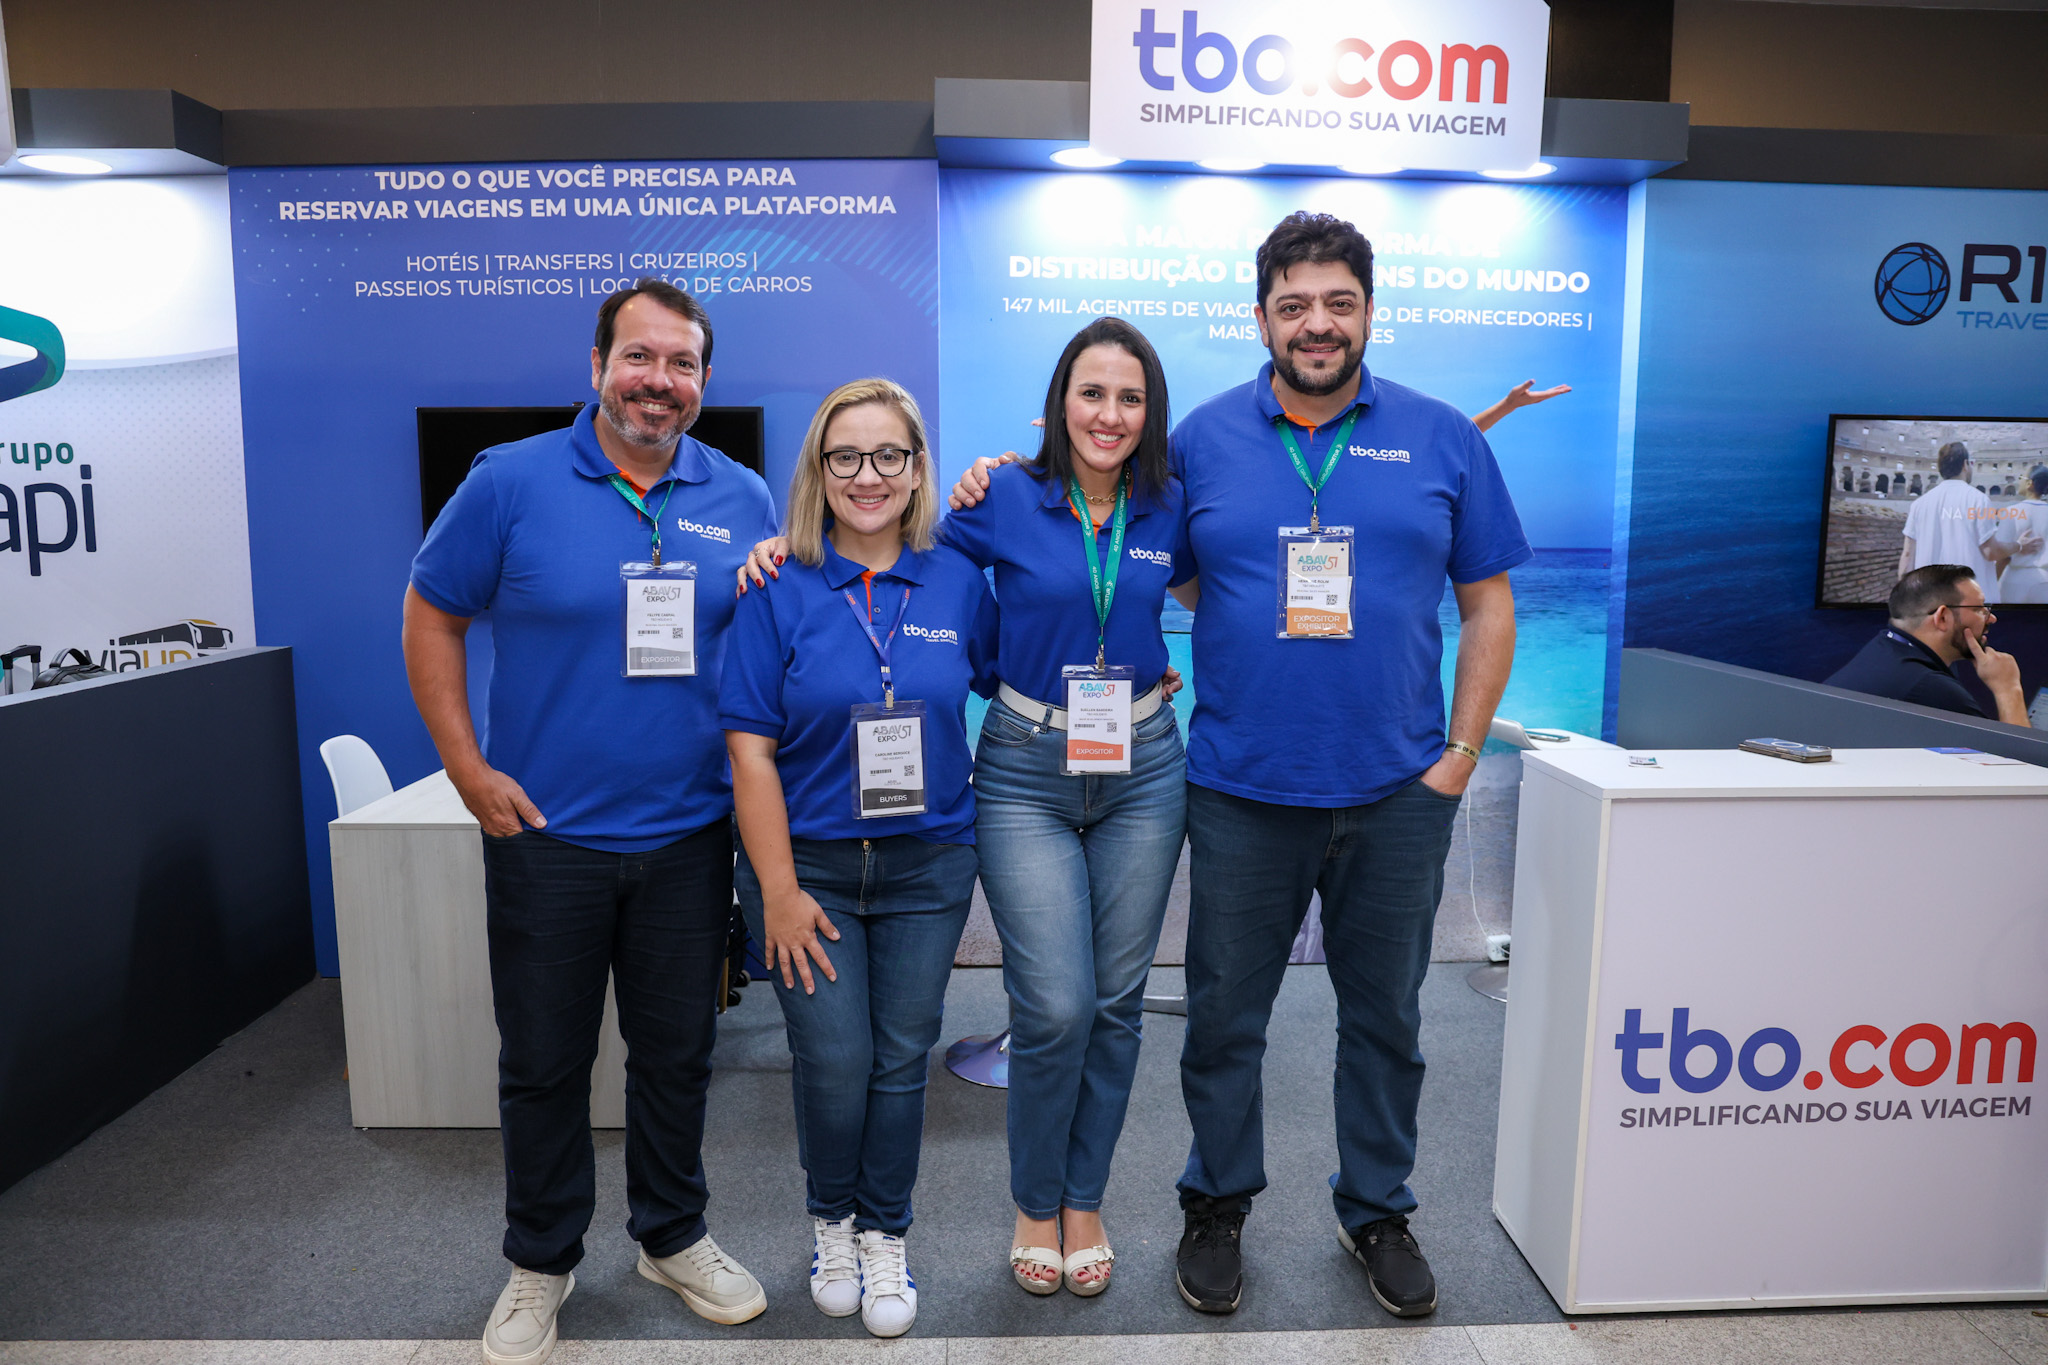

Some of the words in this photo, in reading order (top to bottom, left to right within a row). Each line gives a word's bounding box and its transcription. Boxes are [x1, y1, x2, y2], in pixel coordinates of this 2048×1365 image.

[1133, 8, 1509, 104] tbo.com
[1139, 103, 1342, 129] SIMPLIFICANDO
[1348, 111, 1401, 132] SUA
[1407, 112, 1507, 136] VIAGEM
[374, 170, 445, 190] TUDO
[452, 170, 471, 189] O
[478, 169, 530, 192] QUE
[536, 164, 606, 188] VOCÊ
[612, 167, 720, 187] PRECISA
[727, 167, 797, 186] PARA
[279, 200, 409, 220] RESERVAR
[414, 199, 524, 218] VIAGENS
[530, 198, 567, 217] EM
[574, 198, 632, 217] UMA
[638, 192, 719, 216] ÚNICA
[724, 195, 898, 215] PLATAFORMA
[406, 252, 479, 272] HOTÉIS
[494, 254, 613, 271] TRANSFERS
[629, 252, 747, 270] CRUZEIROS
[1009, 254, 1227, 287] DISTRIBUIÇÃO
[1423, 266, 1468, 290] DO
[1477, 269, 1590, 293] MUNDO
[1959, 243, 2047, 303] R1
[355, 280, 451, 297] PASSEIOS
[457, 276, 573, 295] TURÍSTICOS
[694, 277, 722, 293] DE
[727, 276, 812, 293] CARROS
[1002, 297, 1033, 313] 147
[1038, 298, 1073, 314] MIL
[1076, 299, 1167, 316] AGENTES
[1172, 301, 1199, 317] DE
[1397, 307, 1423, 323] DE
[1428, 308, 1583, 327] FORNECEDORES
[1208, 324, 1257, 340] MAIS
[1348, 445, 1410, 459] tbo.com
[1941, 507, 1963, 520] NA
[1966, 507, 2029, 520] EUROPA
[677, 517, 731, 540] tbo.com
[1129, 547, 1172, 564] tbo.com
[1297, 555, 1328, 565] ABAV
[642, 585, 672, 596] ABAV
[646, 595, 667, 603] EXPO
[1293, 615, 1341, 623] EXPOSITOR
[902, 623, 958, 641] tbo.com
[641, 656, 680, 664] EXPOSITOR
[1078, 683, 1107, 692] ABAV
[872, 724, 902, 737] ABAV
[877, 734, 898, 743] EXPO
[879, 794, 908, 803] BUYERS
[1614, 1007, 2038, 1094] tbo.com
[1619, 1102, 1848, 1128] SIMPLIFICANDO
[1855, 1099, 1912, 1120] SUA
[1921, 1096, 2032, 1119] VIAGEM
